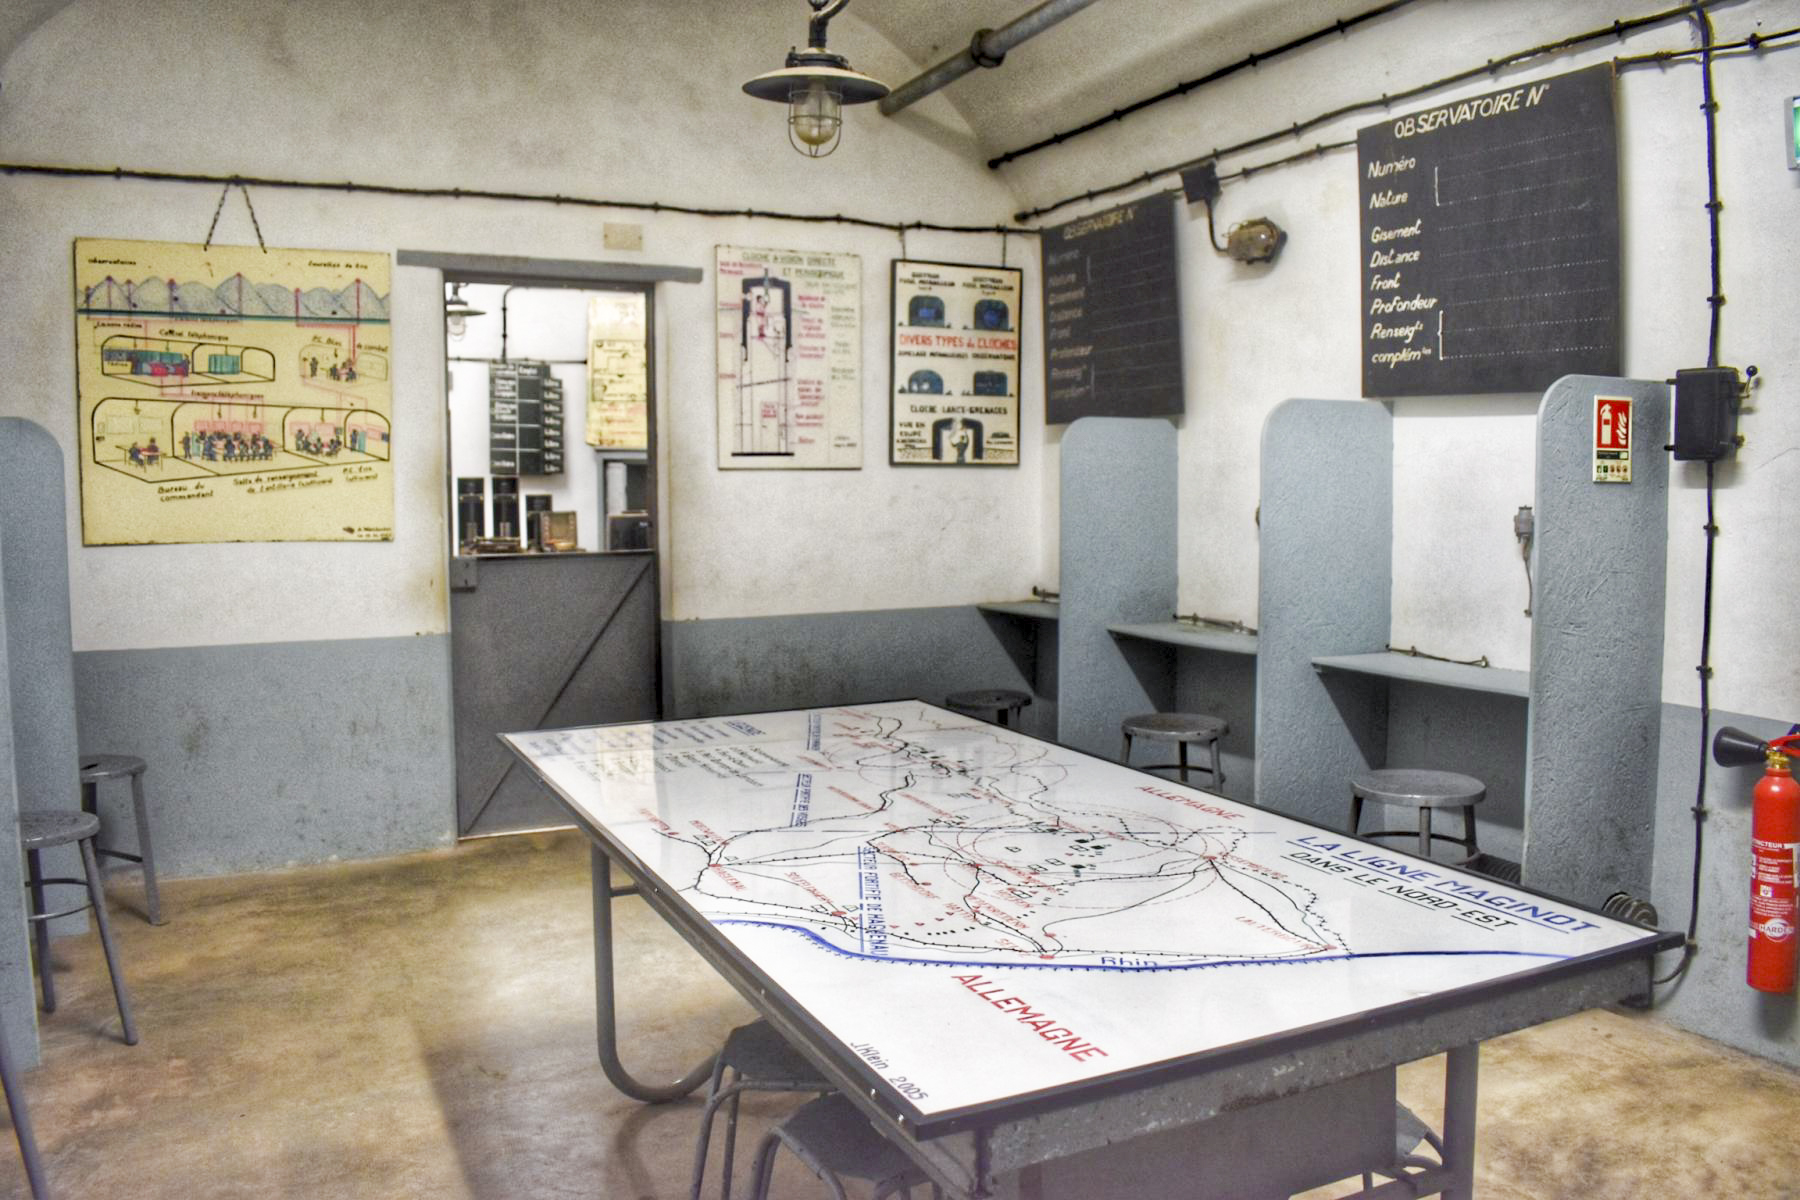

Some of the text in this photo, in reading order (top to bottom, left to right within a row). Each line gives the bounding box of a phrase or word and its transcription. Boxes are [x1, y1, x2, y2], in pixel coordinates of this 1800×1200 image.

[1394, 89, 1524, 138] OBSERVATOIRE
[1368, 155, 1416, 178] Numéro
[1369, 189, 1408, 209] Nature
[1371, 219, 1422, 243] Gisement
[1370, 248, 1420, 267] Distance
[1370, 272, 1401, 290] Front
[1370, 293, 1438, 315] Profondeur
[1138, 786, 1246, 820] ALLEMAGNE
[1289, 851, 1518, 927] DANS LE NORD-EST
[1297, 836, 1601, 931] LA LIGNE MAGINOT
[867, 901, 882, 911] DE
[1101, 957, 1157, 968] Rhin
[951, 974, 1109, 1062] ALLEMAGNE
[889, 1076, 928, 1101] 2005
